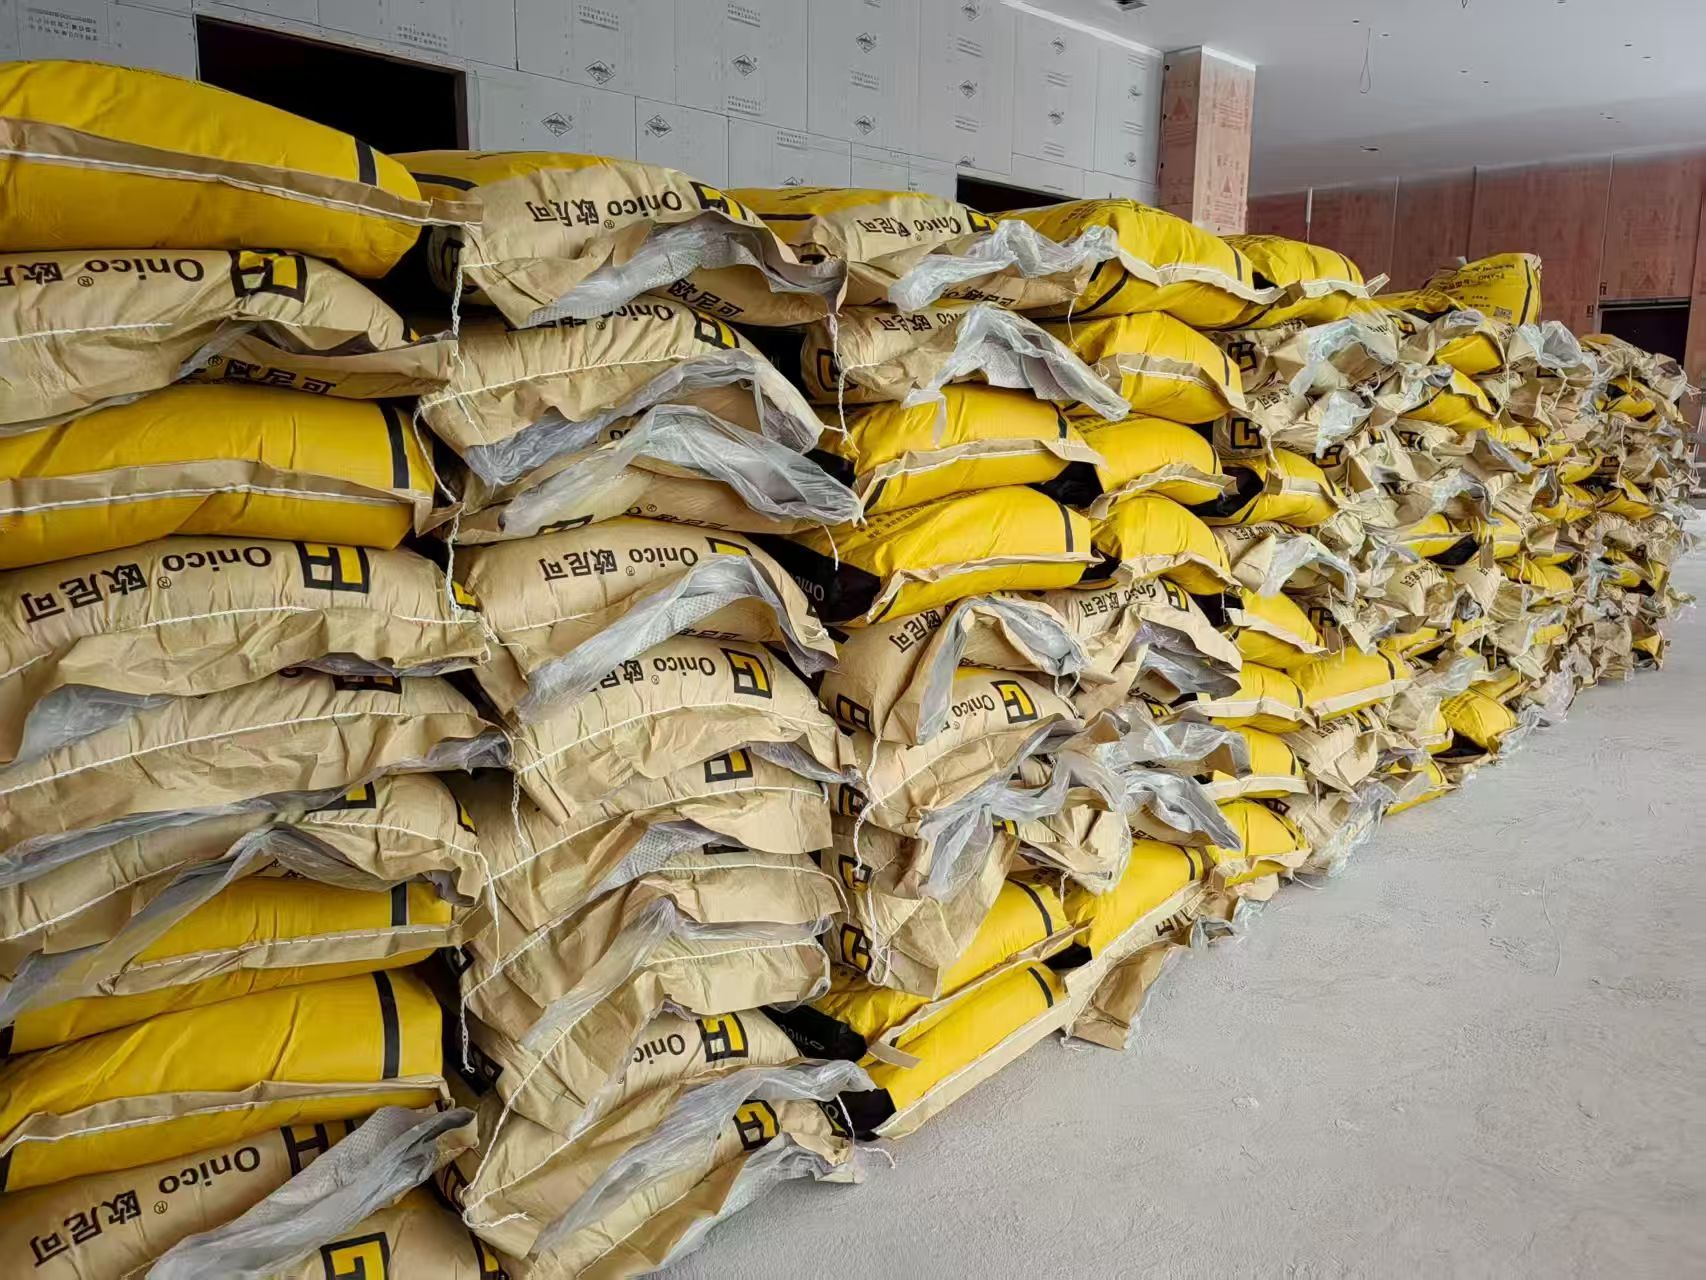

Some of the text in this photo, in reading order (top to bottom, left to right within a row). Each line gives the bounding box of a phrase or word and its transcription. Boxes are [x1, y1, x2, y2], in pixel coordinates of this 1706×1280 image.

[525, 198, 600, 226] 欧尼可
[667, 278, 745, 317] 欧尼可
[538, 549, 618, 581] 欧尼可
[20, 563, 148, 623] 欧尼可
[889, 609, 943, 653] 欧尼可
[633, 1033, 686, 1065] Onic
[29, 1189, 142, 1267] 欧尼可
